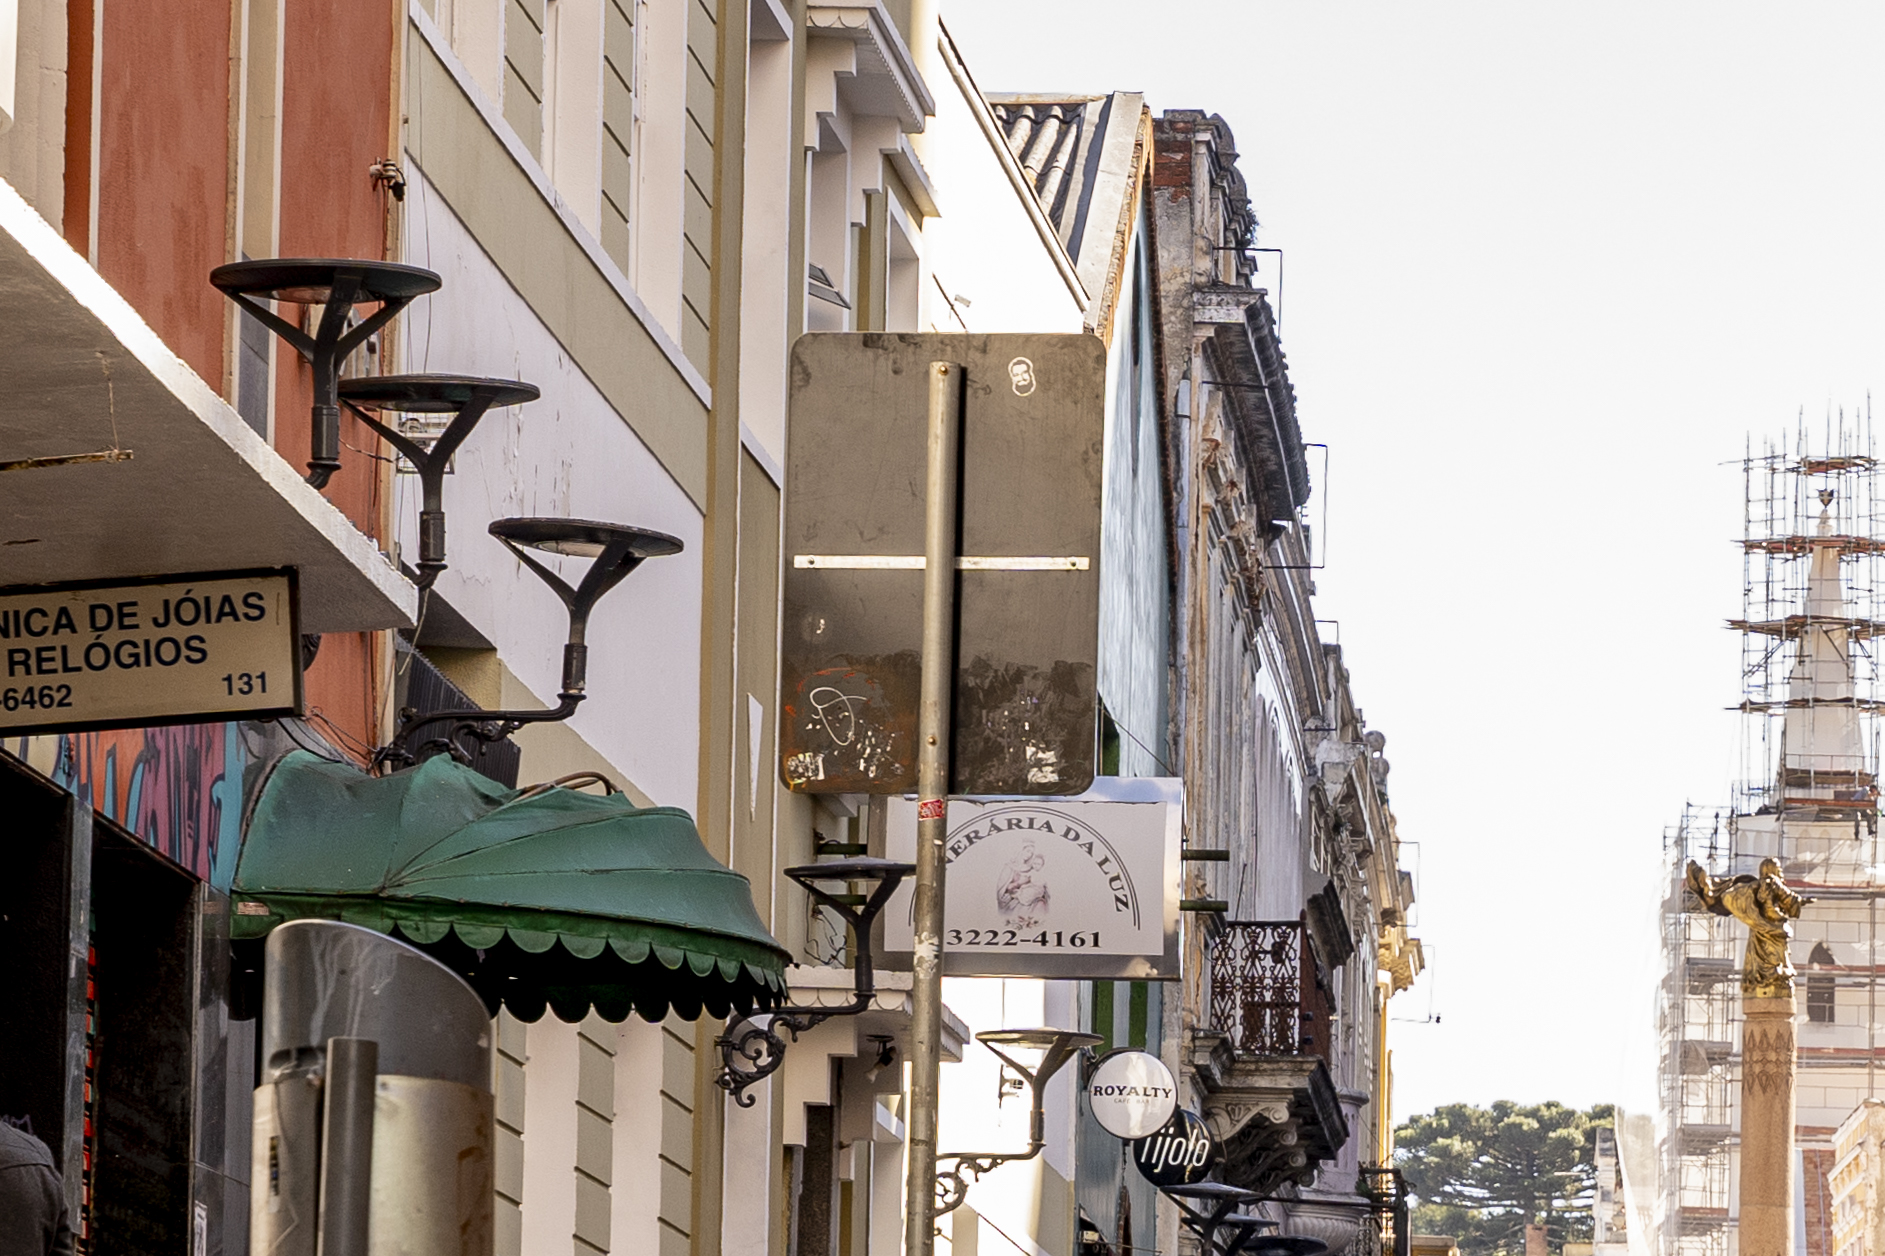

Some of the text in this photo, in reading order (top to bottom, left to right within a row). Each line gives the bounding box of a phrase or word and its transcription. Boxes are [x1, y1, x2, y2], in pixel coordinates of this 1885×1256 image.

[89, 601, 140, 632] DE
[152, 589, 266, 628] JÓIAS
[8, 634, 208, 677] RELÓGIOS
[0, 671, 267, 711] 6462 131
[945, 816, 1130, 913] ERÁRIA DA LUZ
[946, 929, 1102, 949] 3222-4161
[1093, 1085, 1173, 1098] ROYALTY
